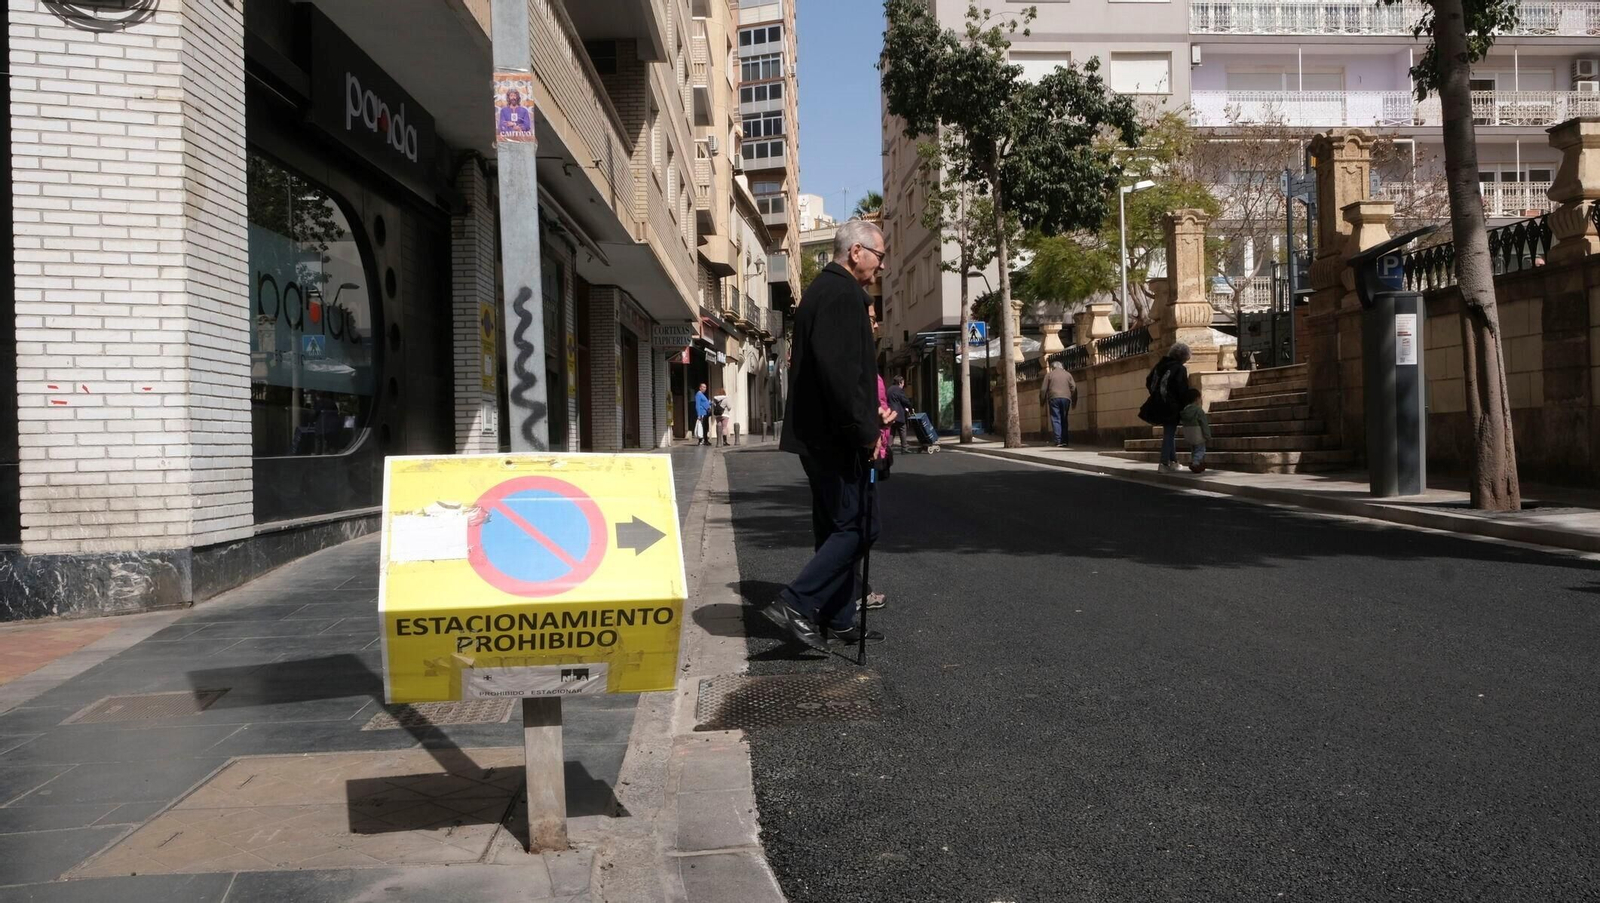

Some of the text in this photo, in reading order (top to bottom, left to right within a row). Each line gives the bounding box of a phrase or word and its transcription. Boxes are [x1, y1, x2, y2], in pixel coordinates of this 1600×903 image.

[346, 72, 417, 163] panda
[1383, 256, 1399, 275] P
[654, 326, 690, 335] CORTINAS
[396, 606, 674, 637] ESTACIONAMIENTO
[457, 629, 617, 654] PROHIBIDO
